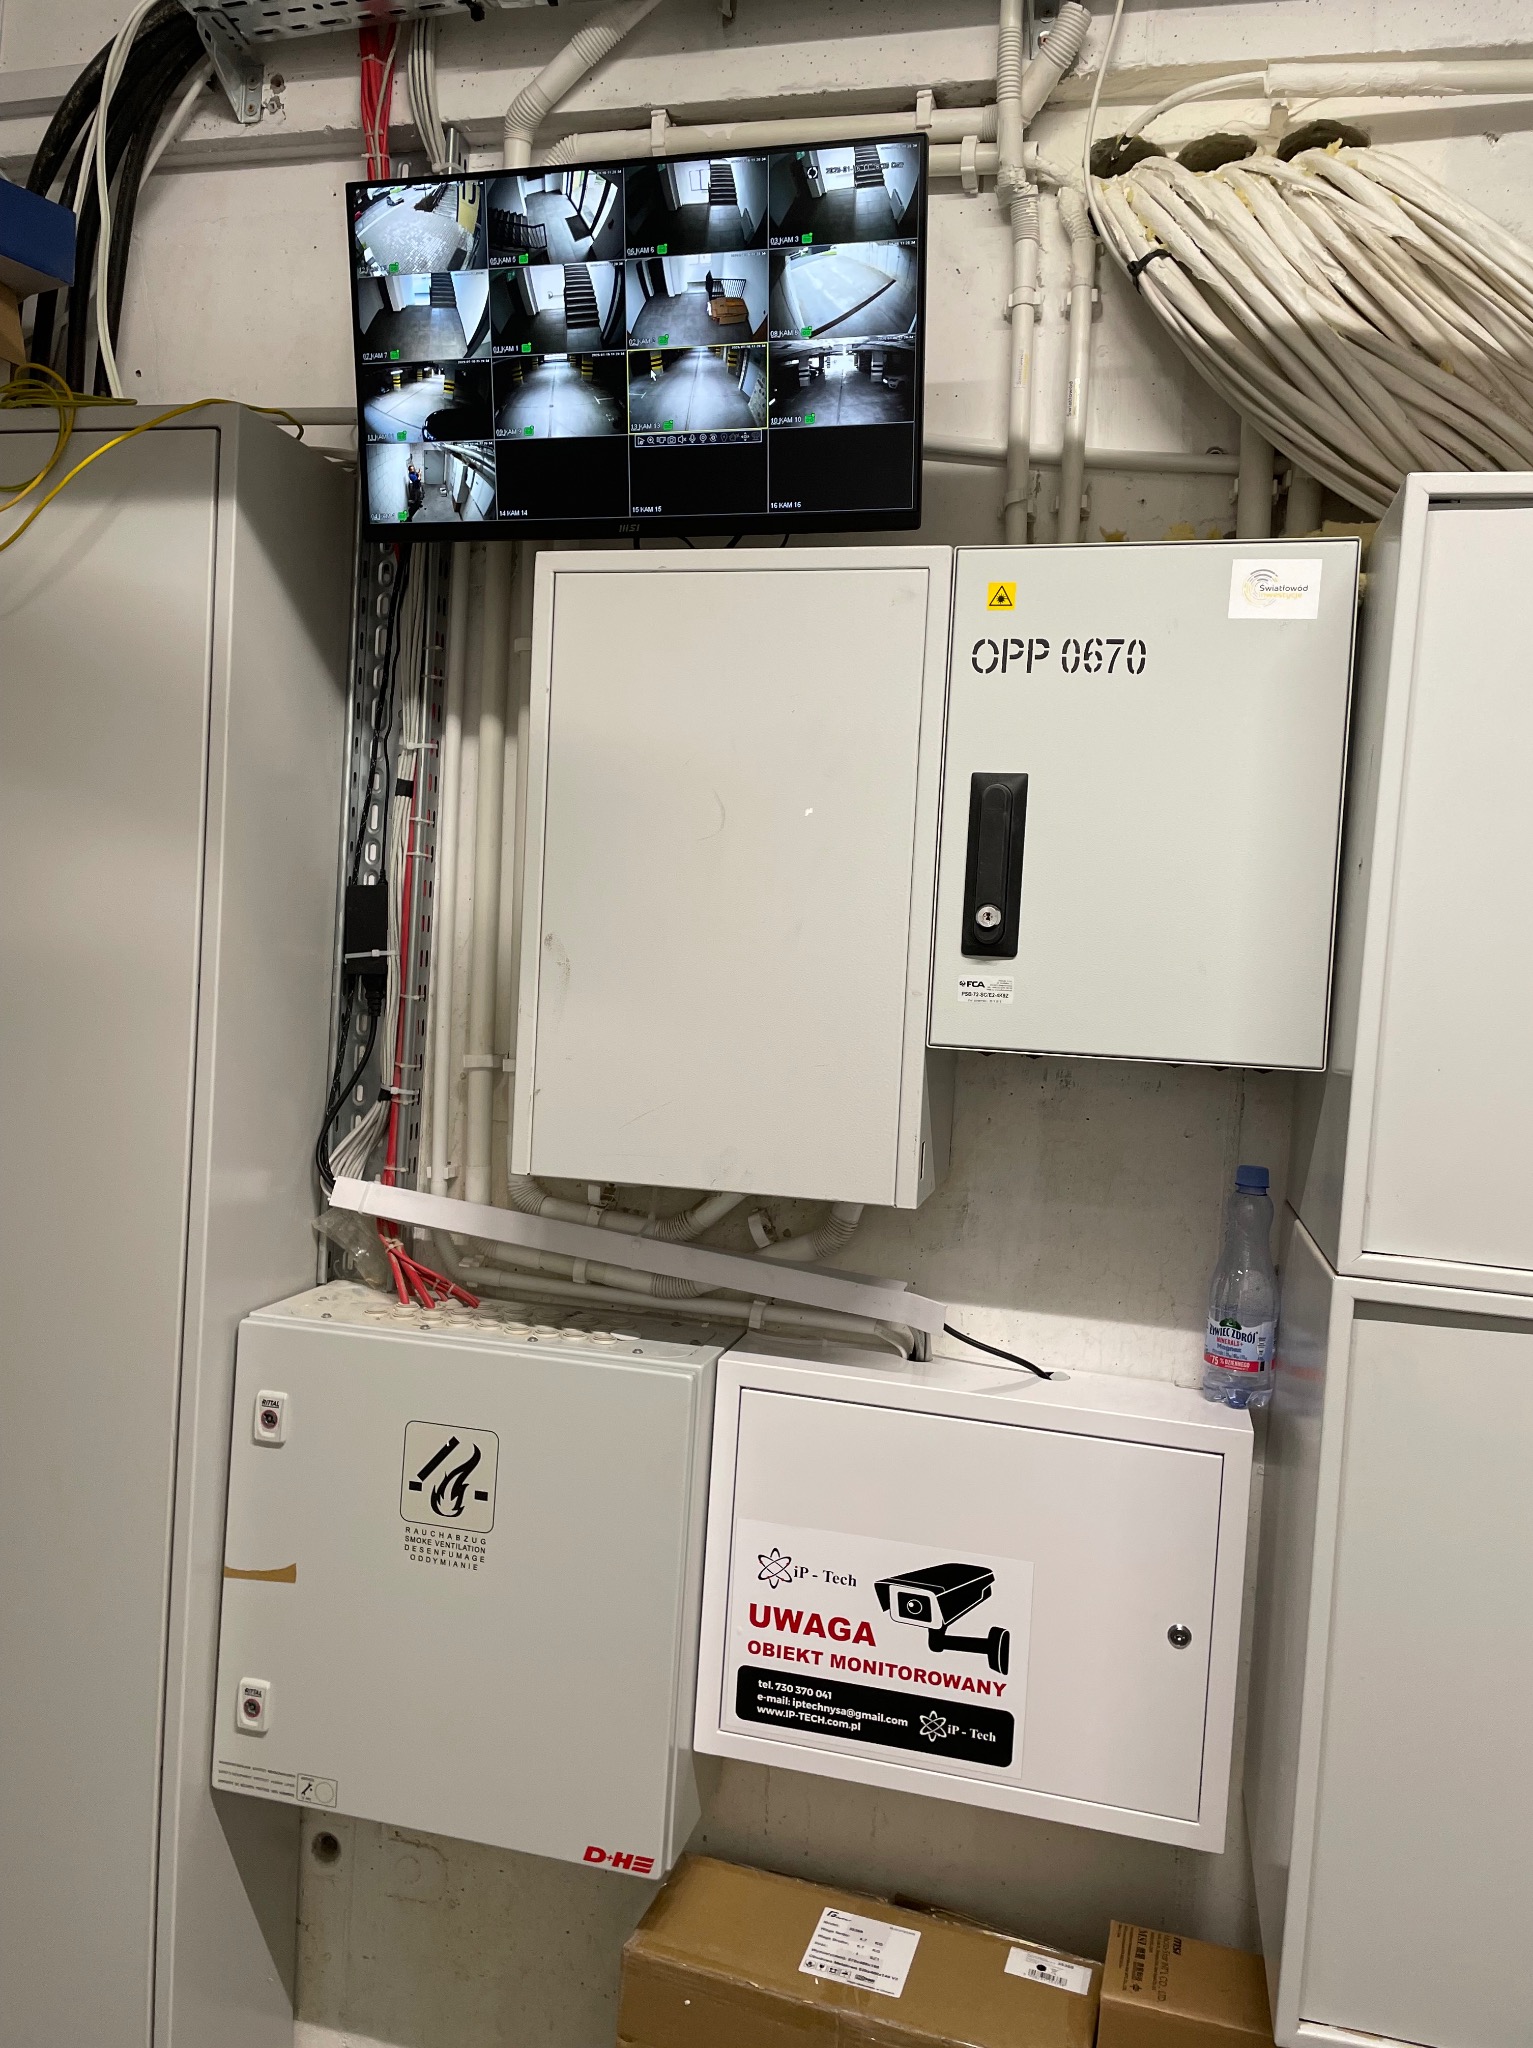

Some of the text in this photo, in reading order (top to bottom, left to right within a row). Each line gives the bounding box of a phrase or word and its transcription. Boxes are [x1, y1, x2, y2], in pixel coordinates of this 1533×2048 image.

[1259, 584, 1308, 592] Światłowód
[972, 638, 1146, 674] OPP 0670
[966, 980, 986, 988] FCA
[1230, 1328, 1256, 1344] ZDRÓJ
[1211, 1356, 1219, 1366] 75
[262, 1399, 280, 1408] RITTAL
[405, 1526, 487, 1545] RAUCHABZUG
[404, 1536, 486, 1554] SMOKE VENTILATION
[404, 1544, 485, 1563] DESENFUMAGE
[410, 1554, 478, 1571] ODDYMIANIE
[823, 1570, 857, 1588] Tech
[749, 1602, 876, 1648] UWAGA
[747, 1640, 1007, 1698] OBIEKT MONITOROWANY
[758, 1679, 832, 1700] tel. 730 370 041
[756, 1706, 861, 1732] www.IP-TECH.com.pl
[757, 1693, 908, 1727] e-mail: iptechnysa@gmail.com
[970, 1728, 997, 1743] Tech
